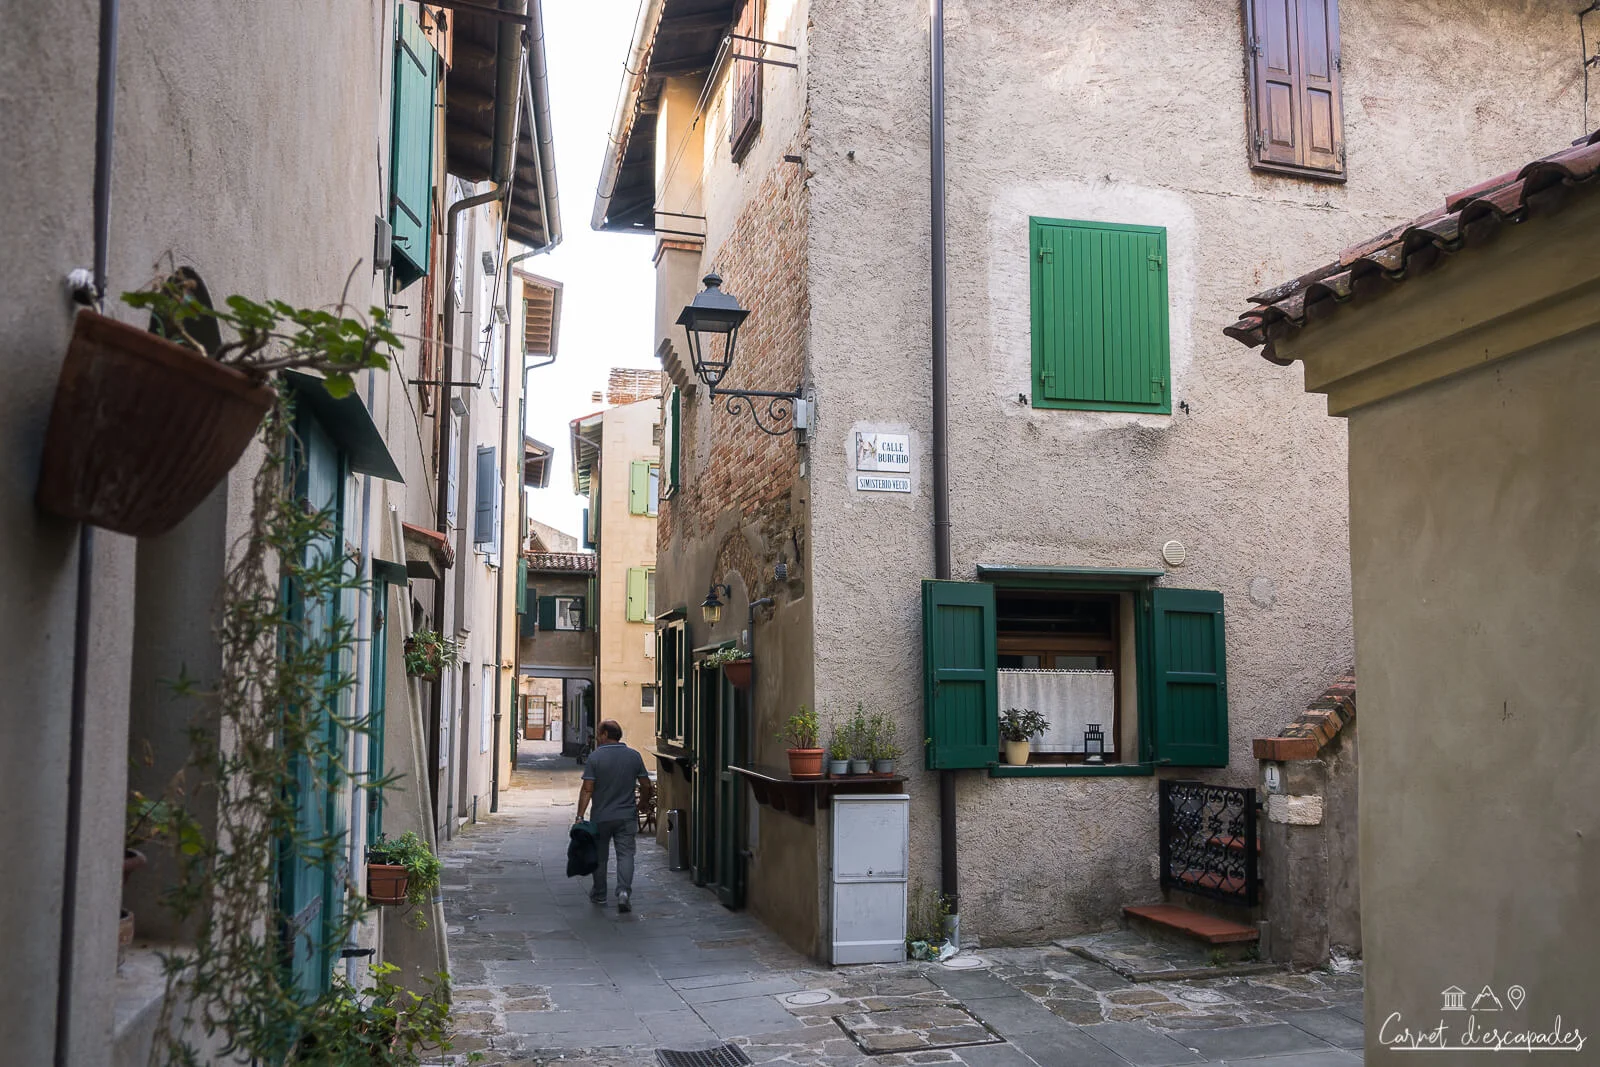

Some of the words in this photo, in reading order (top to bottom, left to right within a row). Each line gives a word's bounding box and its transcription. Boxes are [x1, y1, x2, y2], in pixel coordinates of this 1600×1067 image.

[882, 442, 904, 452] CALLE
[878, 453, 909, 464] BURCHIO
[892, 480, 908, 490] VECIO
